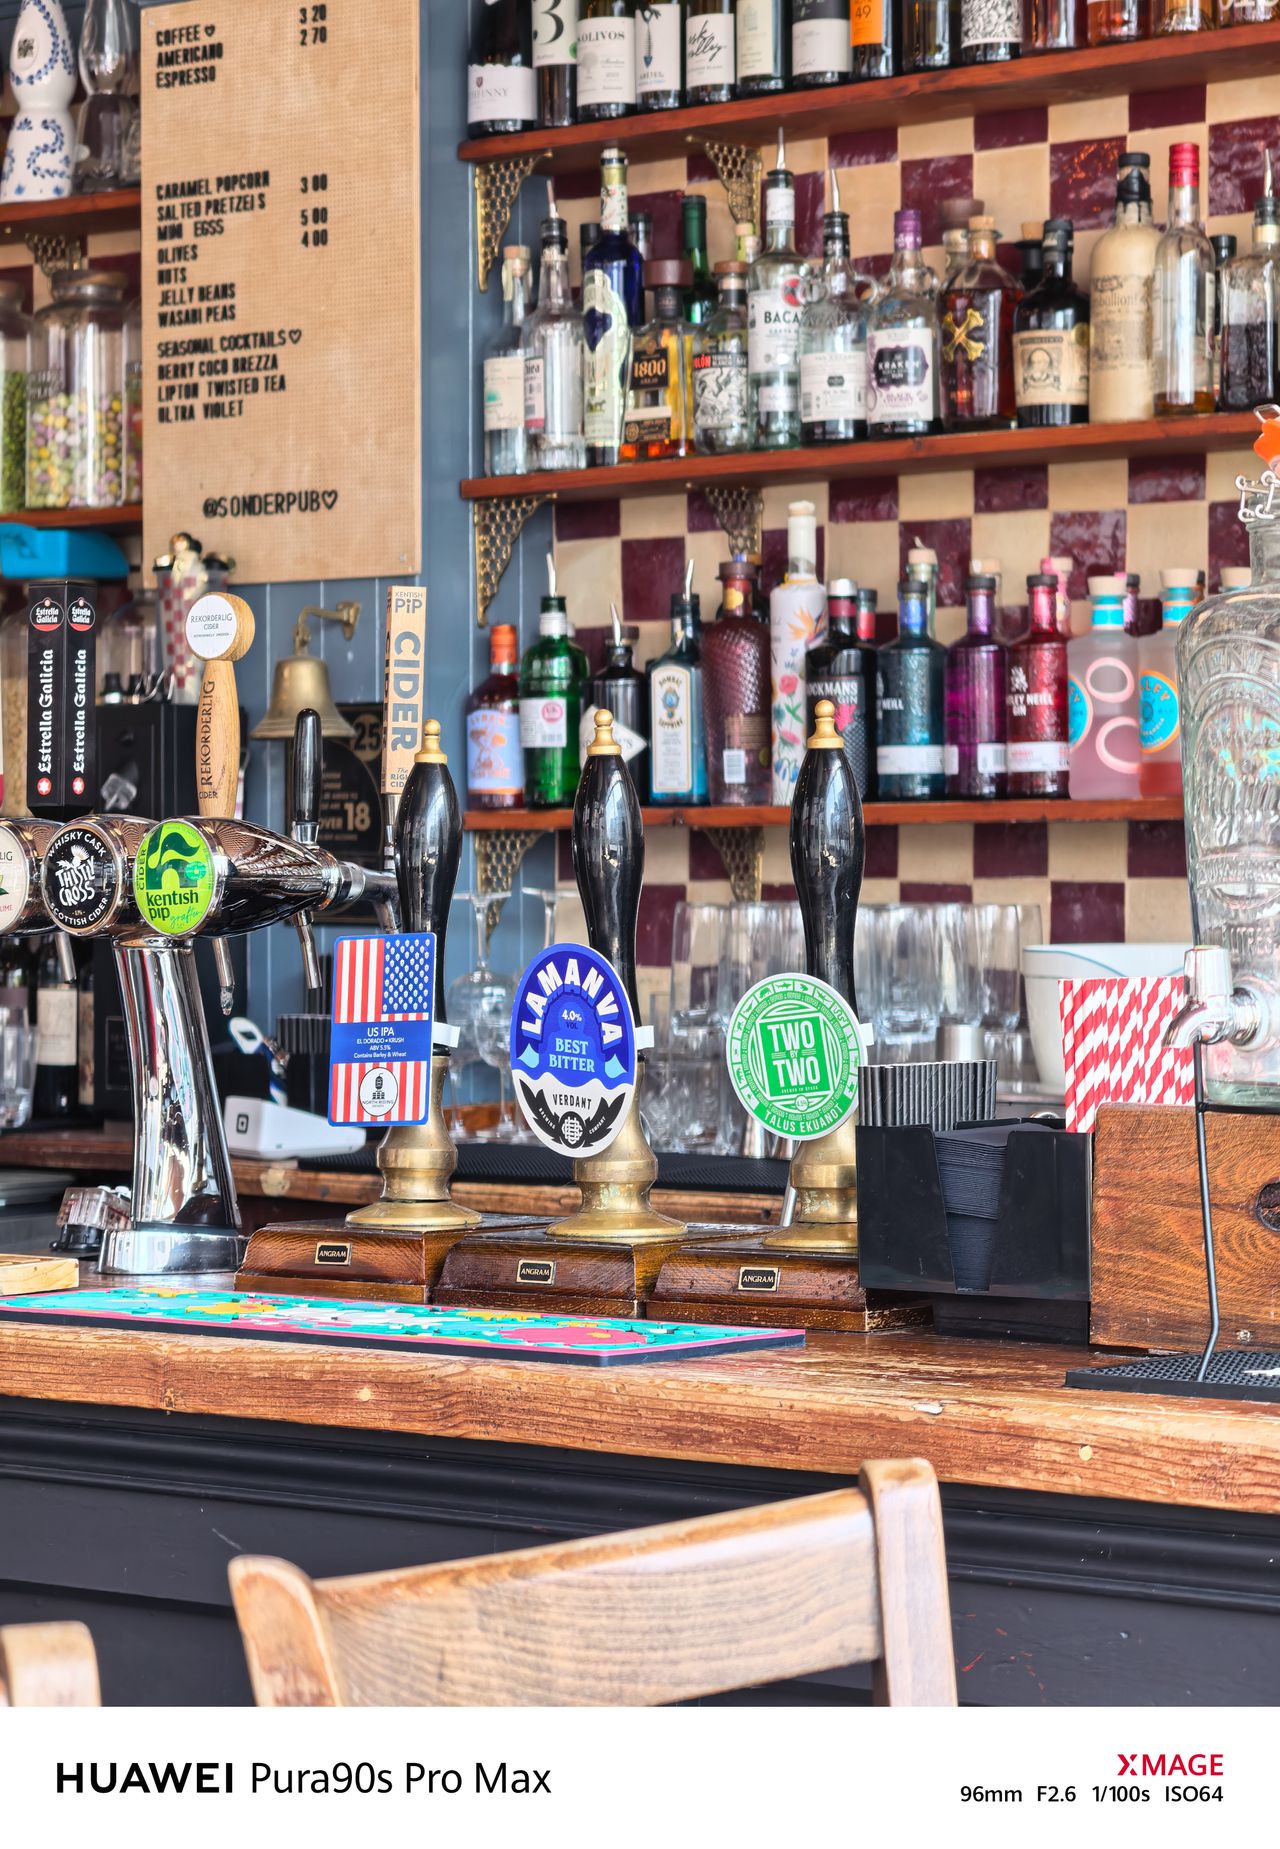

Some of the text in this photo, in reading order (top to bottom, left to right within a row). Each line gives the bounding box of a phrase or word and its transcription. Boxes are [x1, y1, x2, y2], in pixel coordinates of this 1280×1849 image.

[300, 4, 327, 24] 3 20
[156, 24, 201, 47] COFFEE
[300, 26, 327, 46] 2 70
[157, 42, 223, 68] AMERICANO
[157, 65, 216, 88] ESPRESSO
[156, 170, 270, 200] CARAMEL POPCORN
[300, 174, 328, 193] 3 00
[157, 200, 202, 222] SALTED
[300, 207, 328, 226] 5 00
[157, 223, 183, 241] MINI
[301, 229, 328, 248] 4 00
[157, 245, 198, 264] OLIVES
[157, 267, 187, 285] NUTS
[158, 283, 236, 306] JELLY BEANS
[157, 305, 236, 328] WASABI PEAS
[157, 329, 286, 358] SEASONAL COCKTAILS
[158, 354, 278, 380] BERRY COCO BREZZA
[633, 359, 666, 378] 1800
[878, 361, 920, 370] KRAKEN
[158, 375, 286, 402] LIPTON TWISTED TEA
[158, 400, 244, 423] ULTRA VIOLET
[203, 490, 320, 518] @SONDERPUB
[35, 607, 59, 617] Estrella
[36, 615, 58, 624] Galicia
[71, 606, 91, 617] Estrella
[72, 615, 90, 624] Galicia
[191, 612, 232, 624] REKORDERLIG
[658, 675, 683, 686] BOMBAY
[1140, 680, 1170, 701] LFY
[392, 631, 421, 752] CIDER
[837, 696, 858, 705] GIN
[38, 649, 54, 774] Estrella Galicia
[73, 649, 87, 774] Estrella Galicia
[201, 680, 215, 786] REKORDERLIG
[658, 720, 683, 729] SAPPHIRE
[355, 722, 381, 751] 25
[344, 802, 371, 831] 18
[48, 831, 107, 857] WHISKY CASK
[55, 855, 95, 888] THISTLY
[139, 849, 147, 891] CIDER
[59, 881, 95, 906] CROSS
[146, 889, 198, 907] kentish
[50, 897, 108, 926] SCOTTISH CIDER
[148, 906, 170, 921] pip
[521, 958, 623, 1045] LAMANVA
[561, 1009, 583, 1022] 4.0%
[565, 1021, 578, 1030] VOL
[367, 1026, 395, 1037] US IPA
[767, 1020, 815, 1052] TWO
[555, 1037, 588, 1055] BEST
[790, 1050, 798, 1058] BY
[548, 1054, 595, 1073] BITTER
[773, 1056, 820, 1088] TWO
[552, 1093, 592, 1110] VERDANT
[538, 1107, 607, 1135] BREWING COMPANY
[764, 1104, 843, 1133] TALUS EKUANOT
[521, 1268, 550, 1276] ANGRAM
[743, 1275, 774, 1283] ANGRAM
